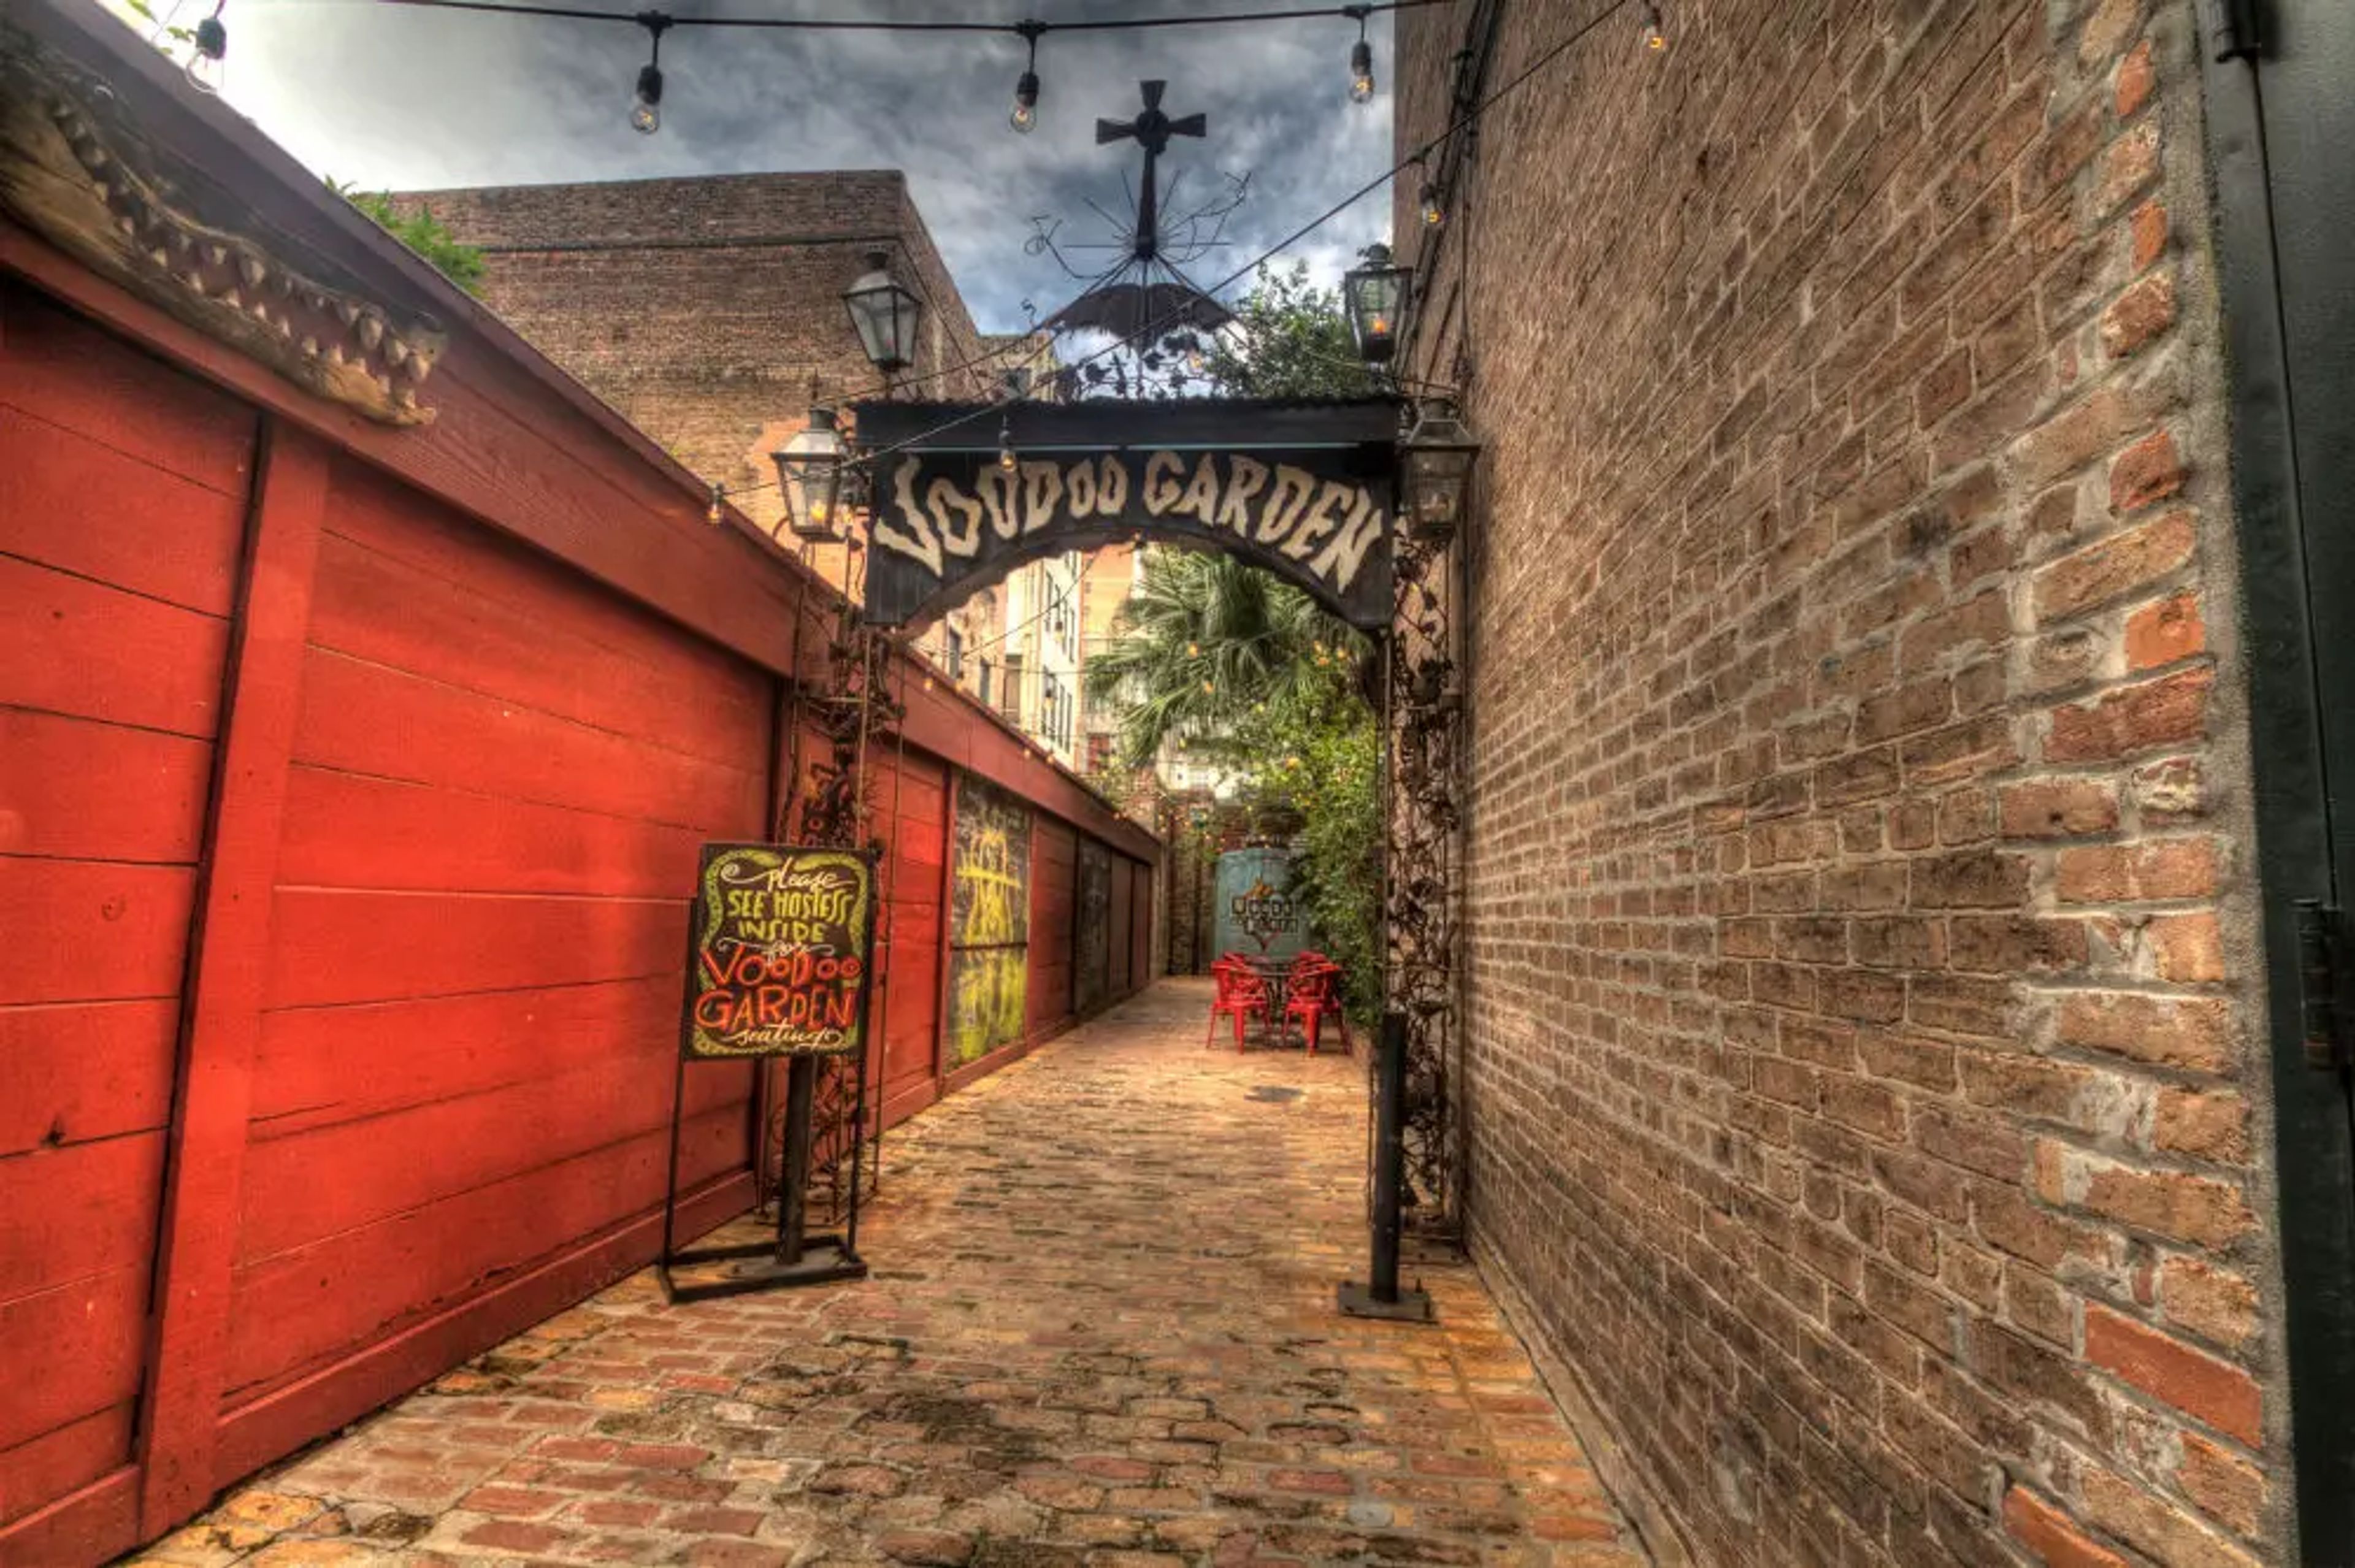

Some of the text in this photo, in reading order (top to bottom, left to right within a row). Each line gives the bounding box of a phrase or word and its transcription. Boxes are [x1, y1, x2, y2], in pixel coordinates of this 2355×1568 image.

[874, 450, 1384, 595] VOODOO GARDEN
[727, 887, 853, 925] SEE HOSTESS
[738, 920, 828, 943] INSIDE
[694, 984, 856, 1033] GARDEN
[722, 1017, 846, 1050] seating
